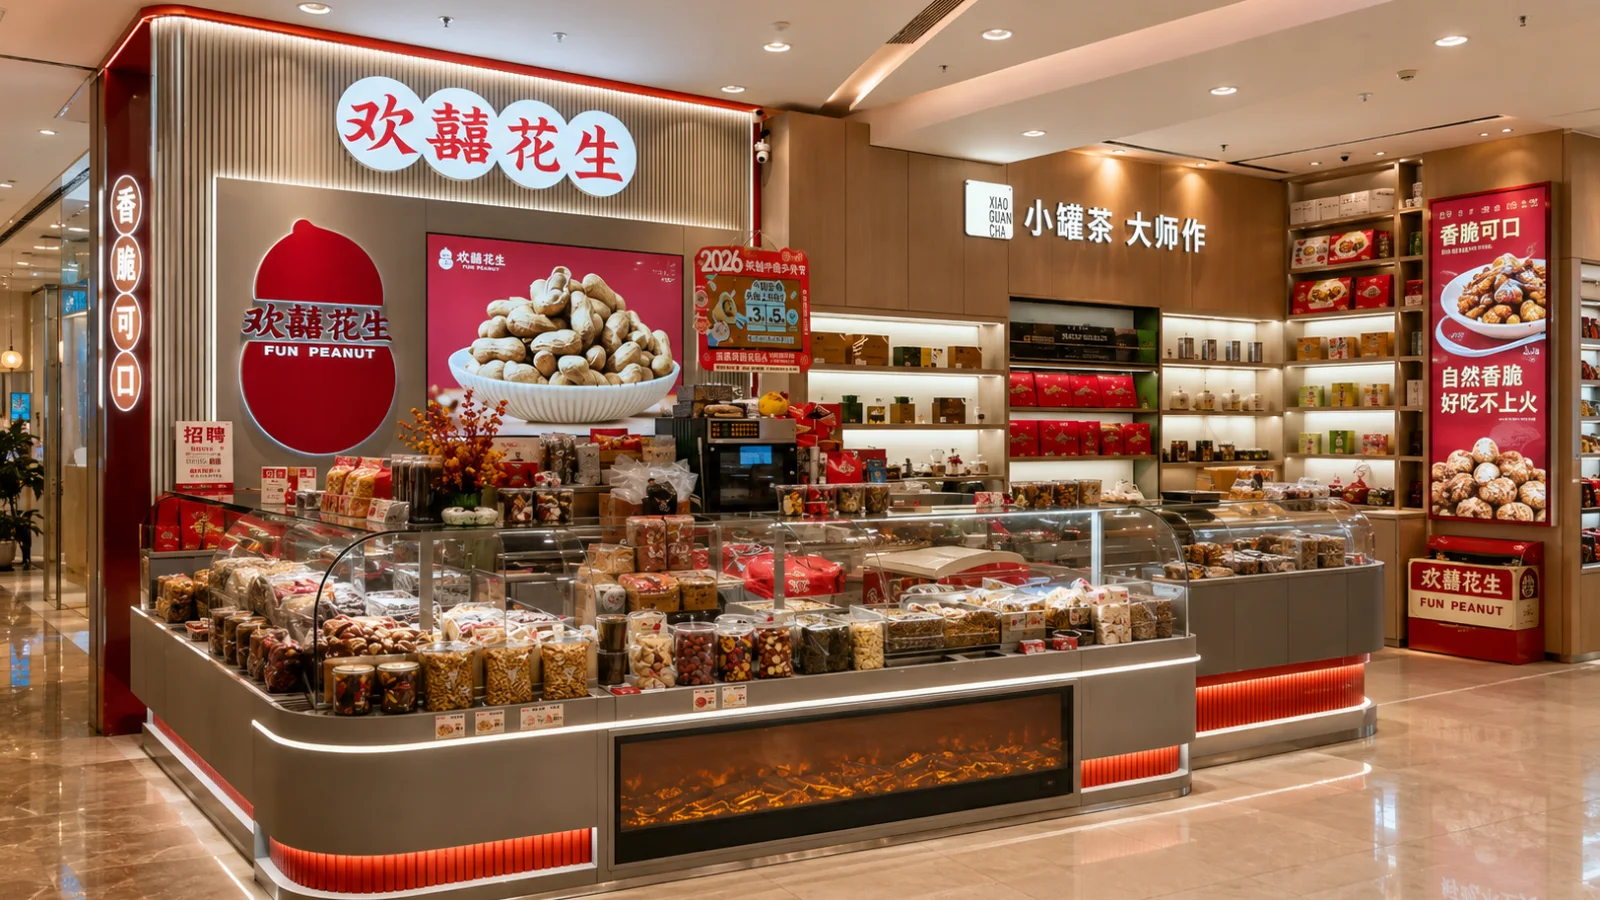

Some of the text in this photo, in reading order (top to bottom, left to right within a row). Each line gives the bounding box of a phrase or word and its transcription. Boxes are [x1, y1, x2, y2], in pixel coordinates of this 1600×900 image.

[344, 94, 623, 182] 欢囍花生
[989, 196, 1009, 209] XIAO
[989, 210, 1012, 224] GUAN
[1024, 199, 1206, 253] 小罐茶 大师作
[989, 225, 1006, 238] CHA
[1440, 217, 1520, 246] 香脆可口
[700, 249, 744, 273] 2026
[116, 186, 136, 397] 香脆可口
[241, 303, 392, 342] 欢囍花生
[264, 345, 375, 359] FUN PEANUT
[1442, 364, 1523, 388] 自然香脆
[1440, 391, 1538, 414] 好吃不上火
[184, 426, 225, 444] 招聘
[1421, 567, 1503, 595] 欢囍花生
[1420, 597, 1503, 616] FUN PEANUT
